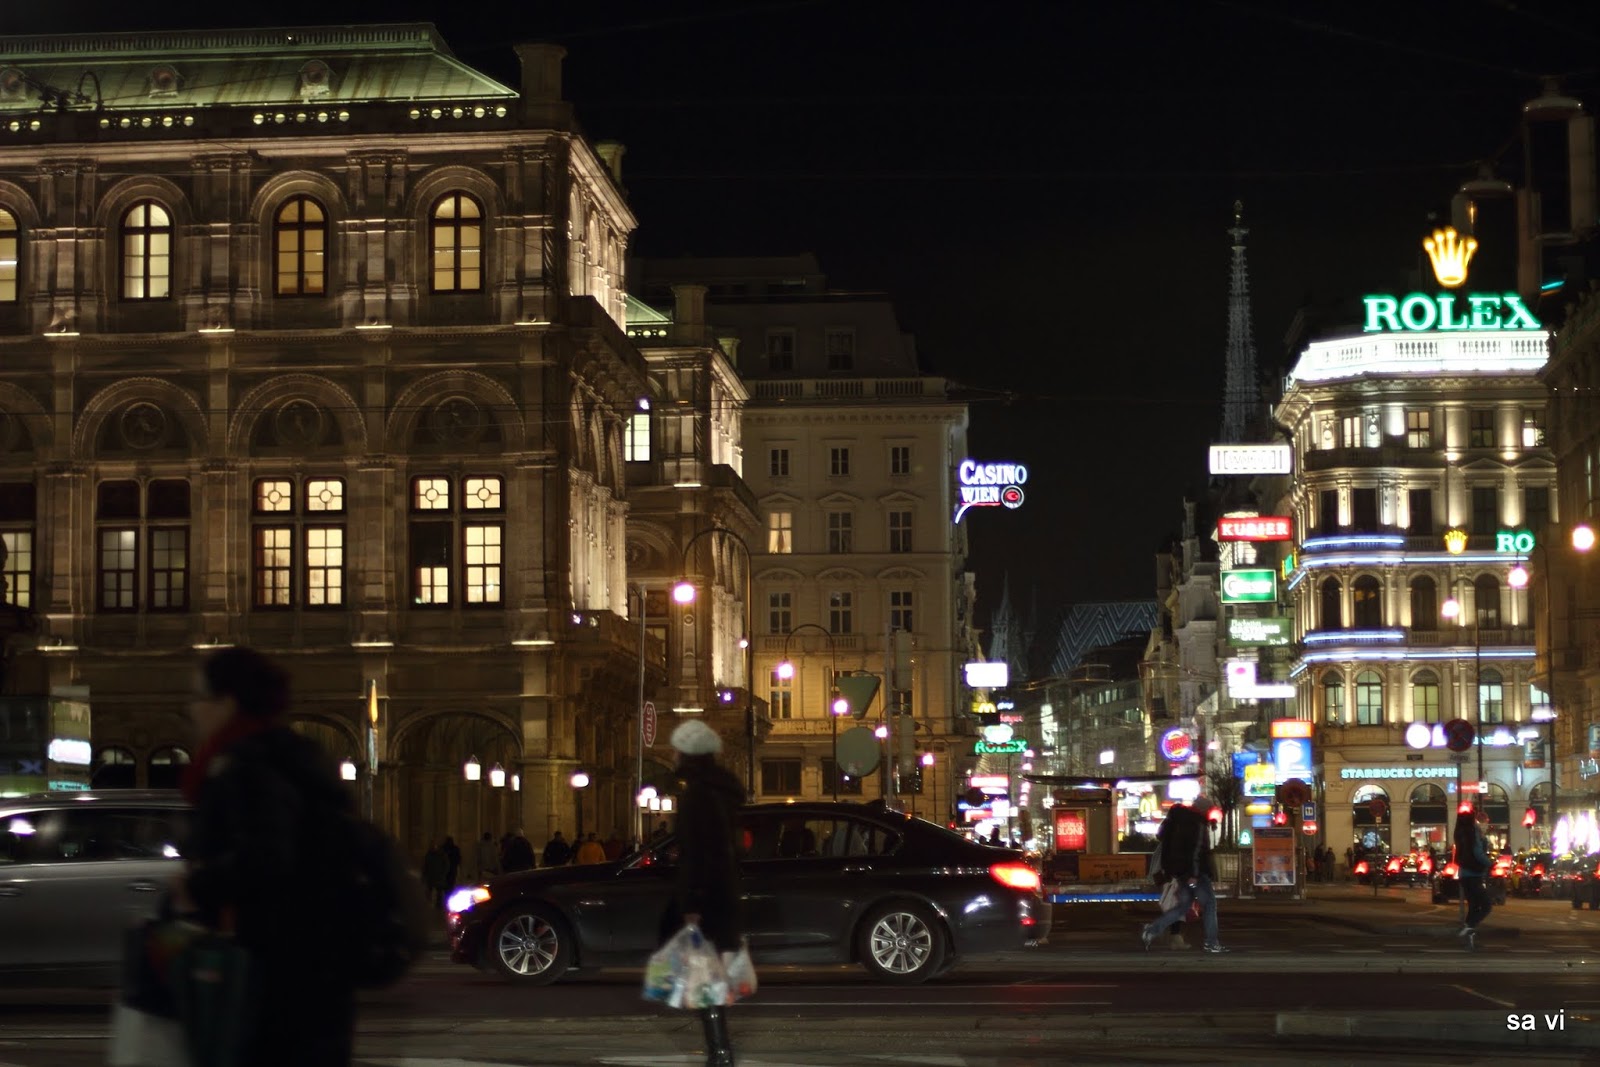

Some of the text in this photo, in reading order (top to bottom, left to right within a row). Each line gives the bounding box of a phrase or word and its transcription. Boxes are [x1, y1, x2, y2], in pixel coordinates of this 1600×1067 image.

[1363, 294, 1541, 332] ROLEX
[959, 460, 1028, 485] CASINO
[960, 486, 1000, 503] WIEN
[1221, 522, 1288, 536] KURIER
[1496, 530, 1534, 552] RO
[1341, 768, 1413, 779] STARBUCKS
